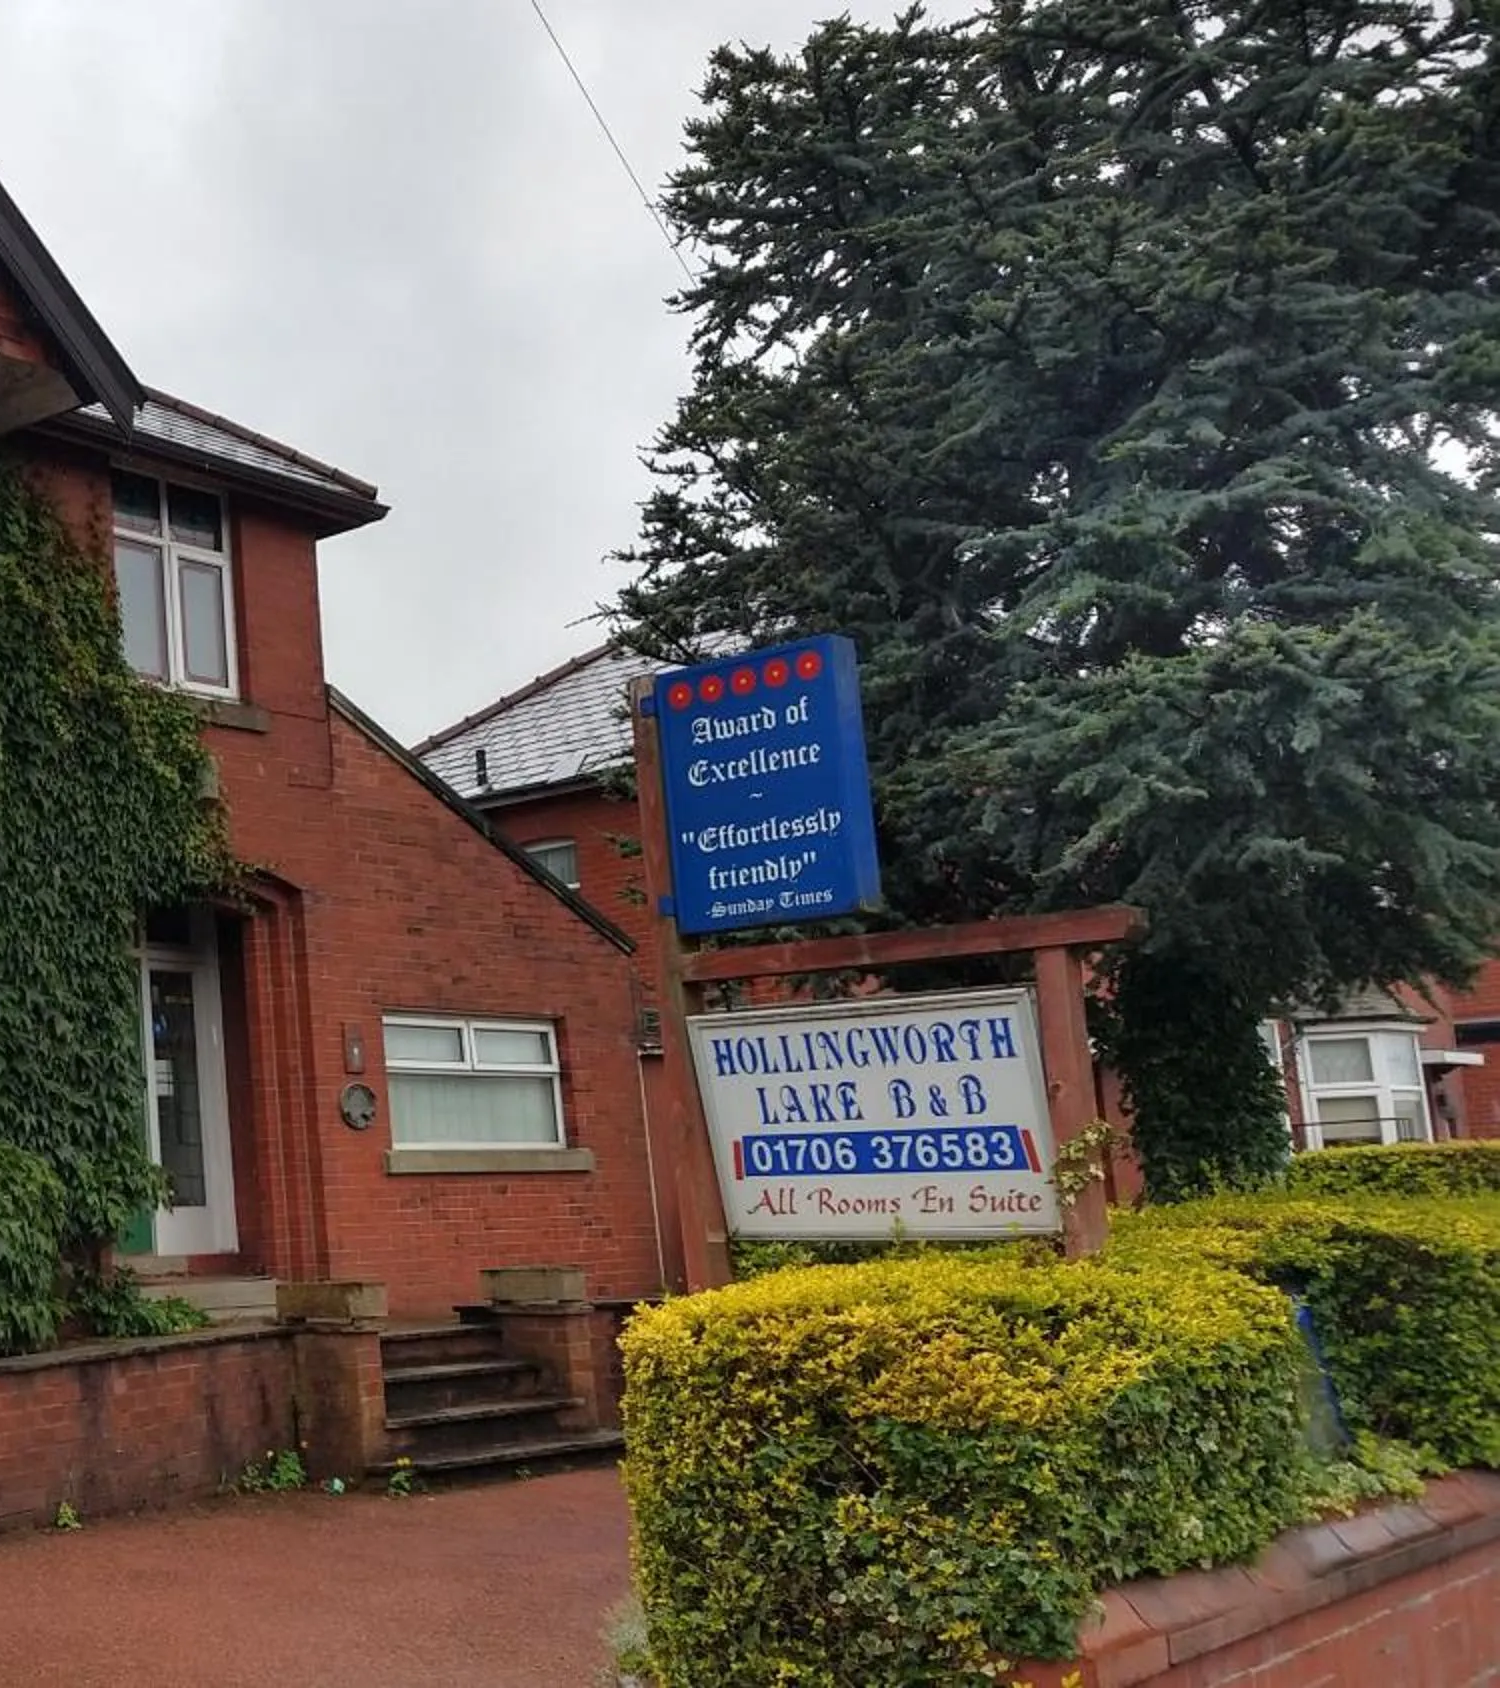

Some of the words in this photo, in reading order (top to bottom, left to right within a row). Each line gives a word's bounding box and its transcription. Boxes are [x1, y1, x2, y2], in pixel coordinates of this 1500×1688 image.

[691, 706, 776, 745] Award
[785, 695, 808, 725] of
[688, 743, 821, 787] Excellence
[681, 807, 841, 853] "Effortlessly
[708, 851, 817, 890] friendly"
[779, 888, 833, 908] Times
[711, 1016, 1019, 1077] HOLLINGWORTH
[756, 1079, 864, 1126] LAKE
[751, 1136, 857, 1173] 01706
[871, 1131, 1016, 1171] 376583
[747, 1187, 797, 1216] All
[806, 1187, 900, 1216] Rooms
[911, 1184, 954, 1213] En
[968, 1188, 1042, 1214] Suite
